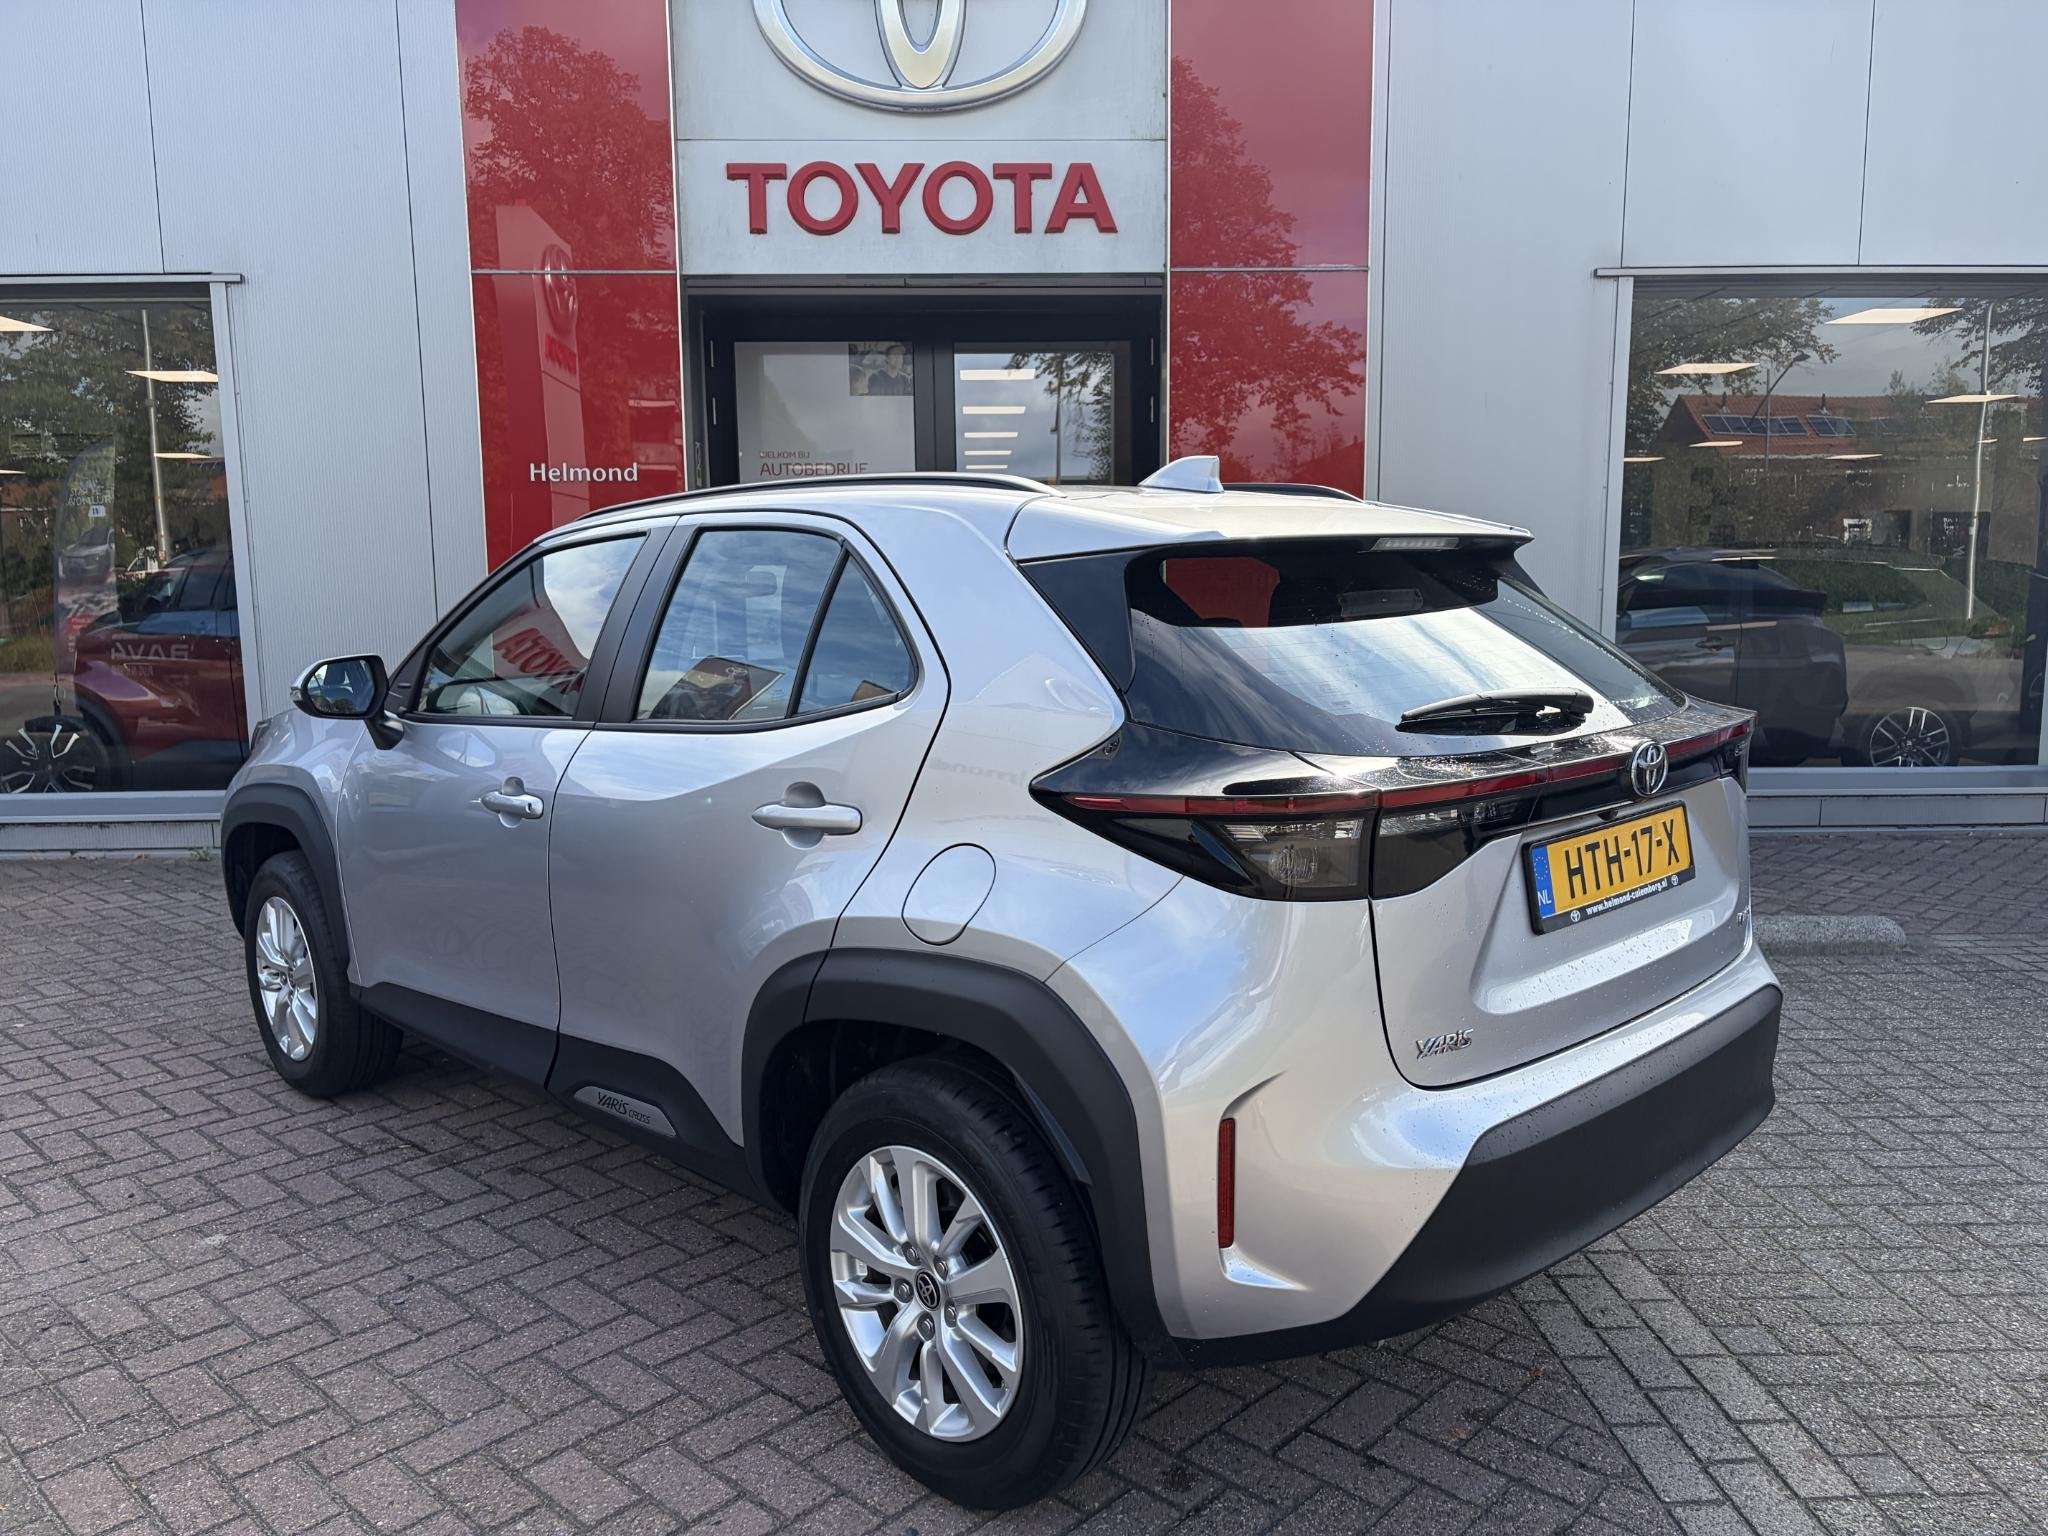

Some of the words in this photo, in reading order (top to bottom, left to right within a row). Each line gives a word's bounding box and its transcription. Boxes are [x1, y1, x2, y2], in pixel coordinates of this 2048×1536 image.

[726, 160, 1118, 235] TOYOTA
[529, 462, 639, 482] Helmond
[760, 462, 868, 476] AUTOBEDRIJF
[1564, 818, 1680, 900] HTH-17-X
[1537, 890, 1552, 906] NL
[1585, 878, 1668, 917] www.helmond-culemborg.nl
[1416, 1028, 1475, 1062] YARIS
[597, 1091, 629, 1115] YARIS
